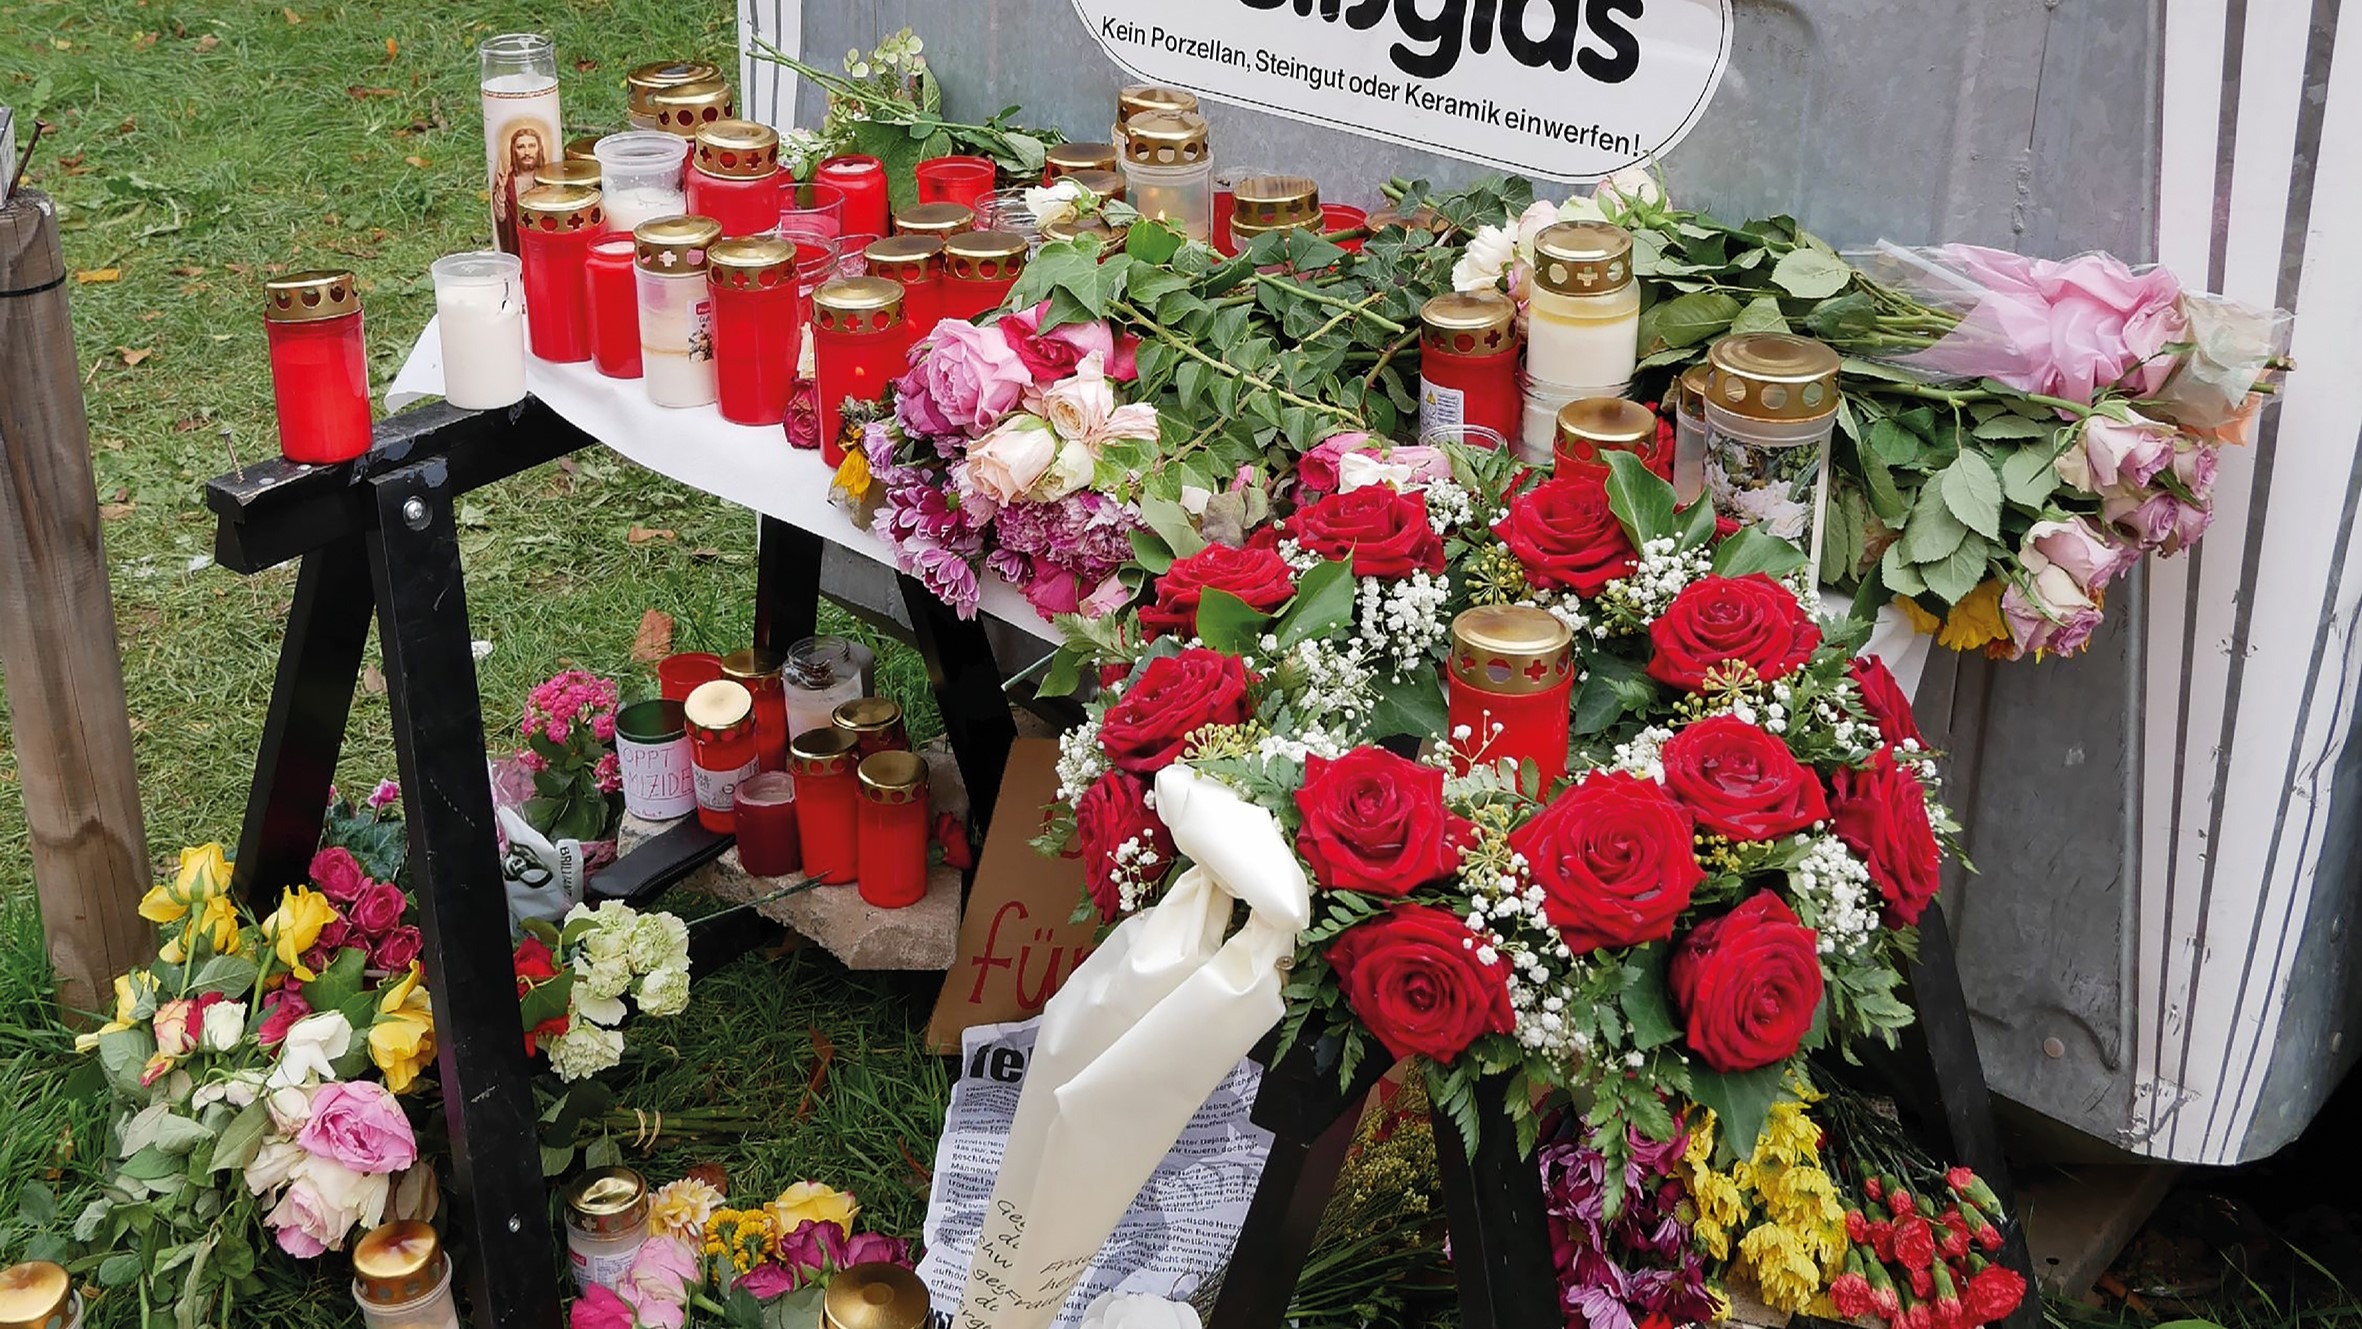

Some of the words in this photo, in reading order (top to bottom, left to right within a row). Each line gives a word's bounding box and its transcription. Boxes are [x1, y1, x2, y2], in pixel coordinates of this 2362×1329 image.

[1101, 16, 1146, 45] Kein
[1151, 26, 1251, 72] Porzellan,
[1255, 49, 1345, 90] Steingut
[1349, 73, 1400, 102] oder
[1405, 82, 1500, 126] Keramik
[1504, 108, 1640, 157] einwerfen!
